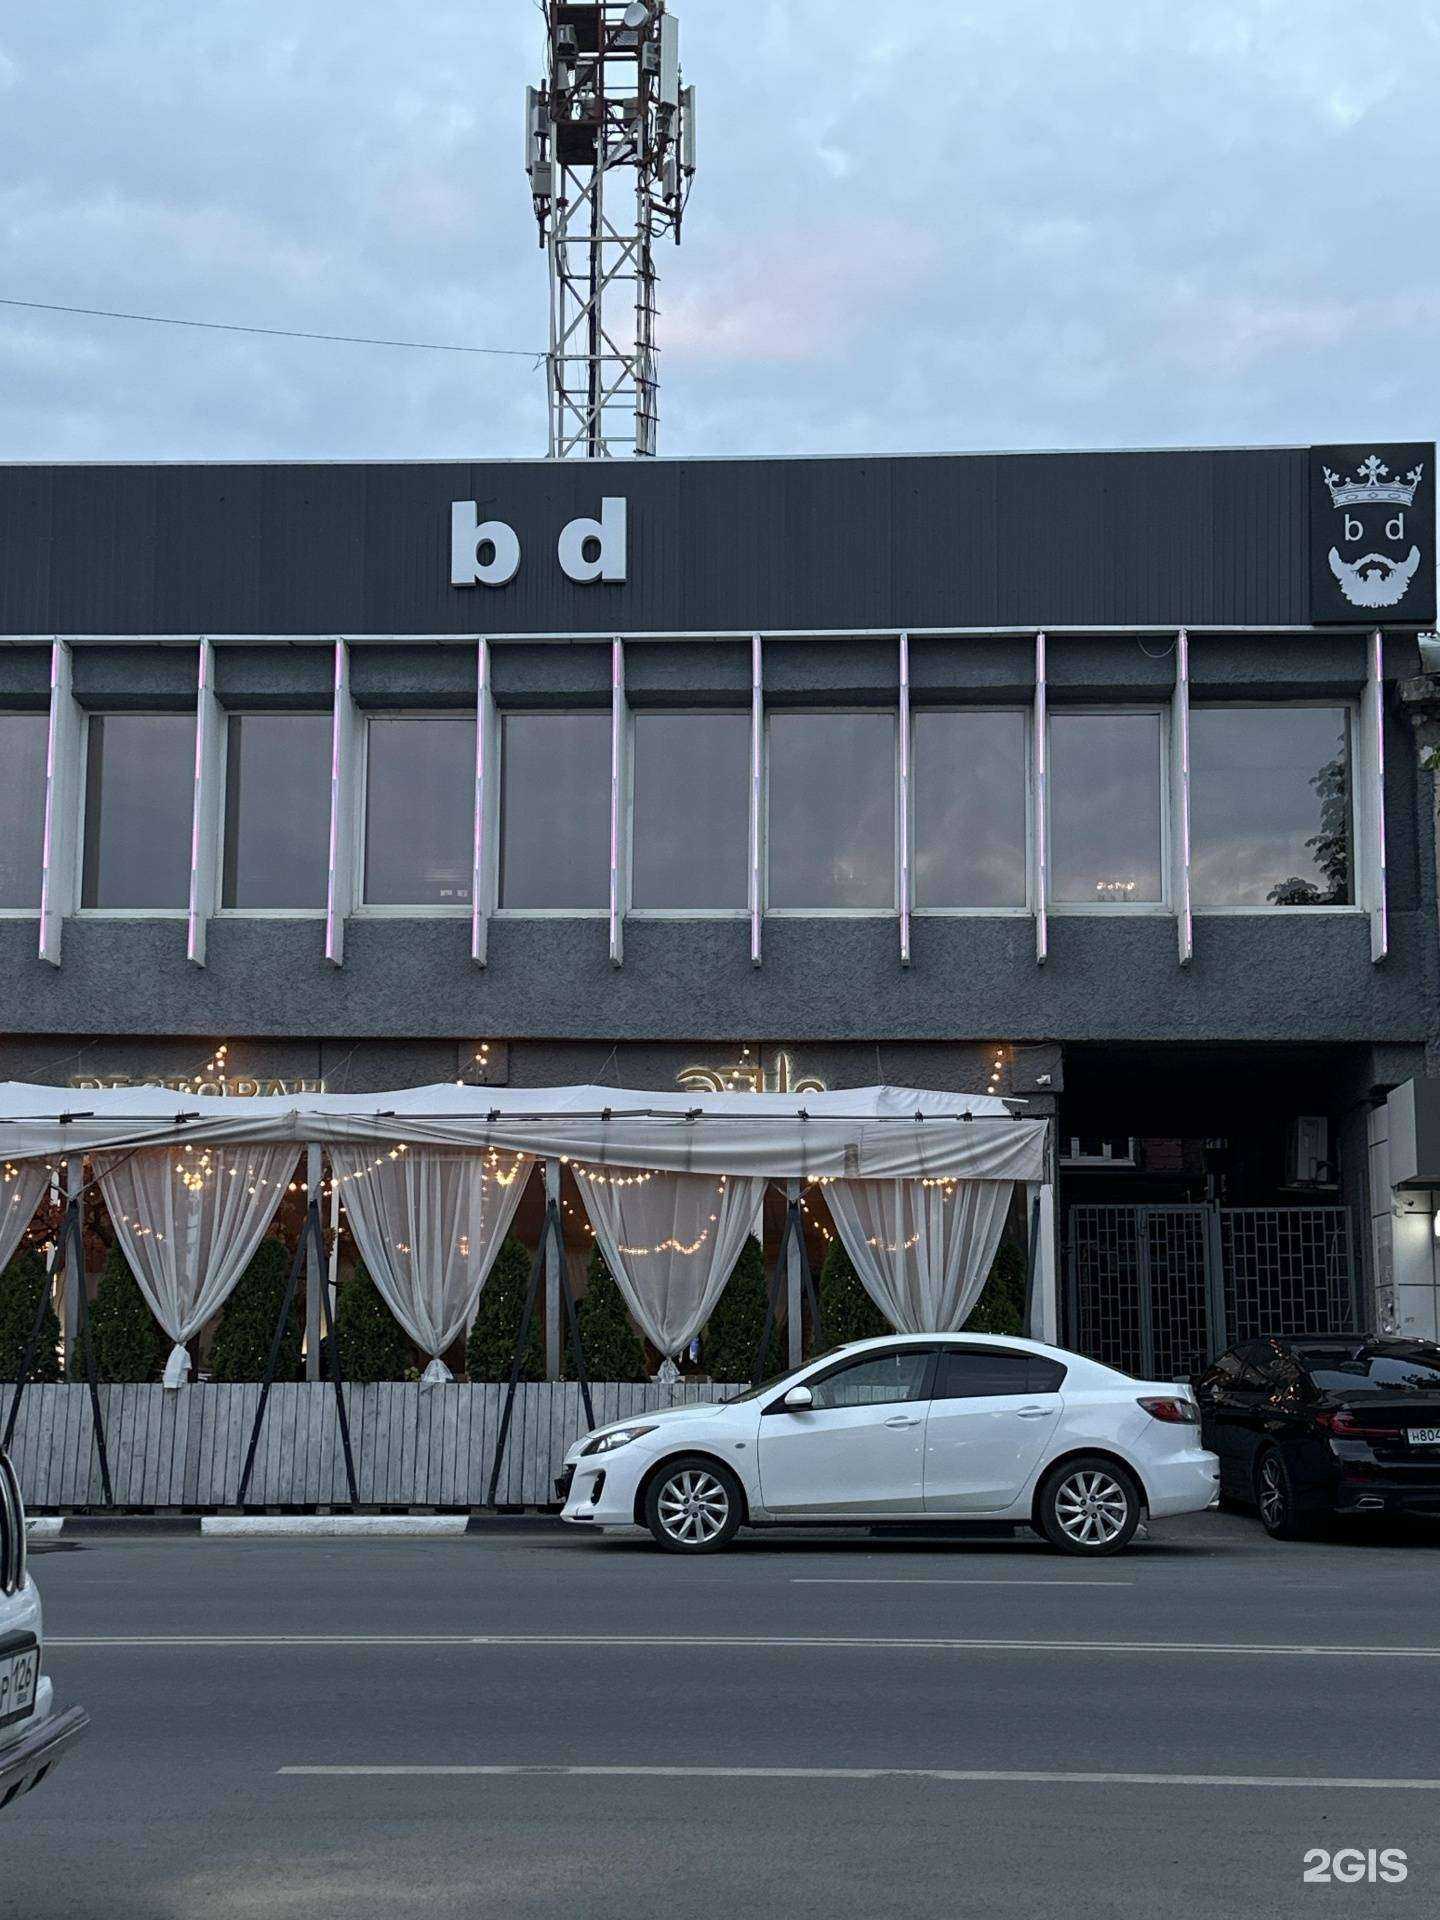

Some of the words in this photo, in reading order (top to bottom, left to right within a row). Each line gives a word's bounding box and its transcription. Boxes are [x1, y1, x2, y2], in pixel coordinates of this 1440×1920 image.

[451, 500, 521, 587] b
[557, 496, 627, 584] d
[1345, 513, 1364, 541] b
[1385, 512, 1404, 540] d
[14, 1655, 32, 1693] 126
